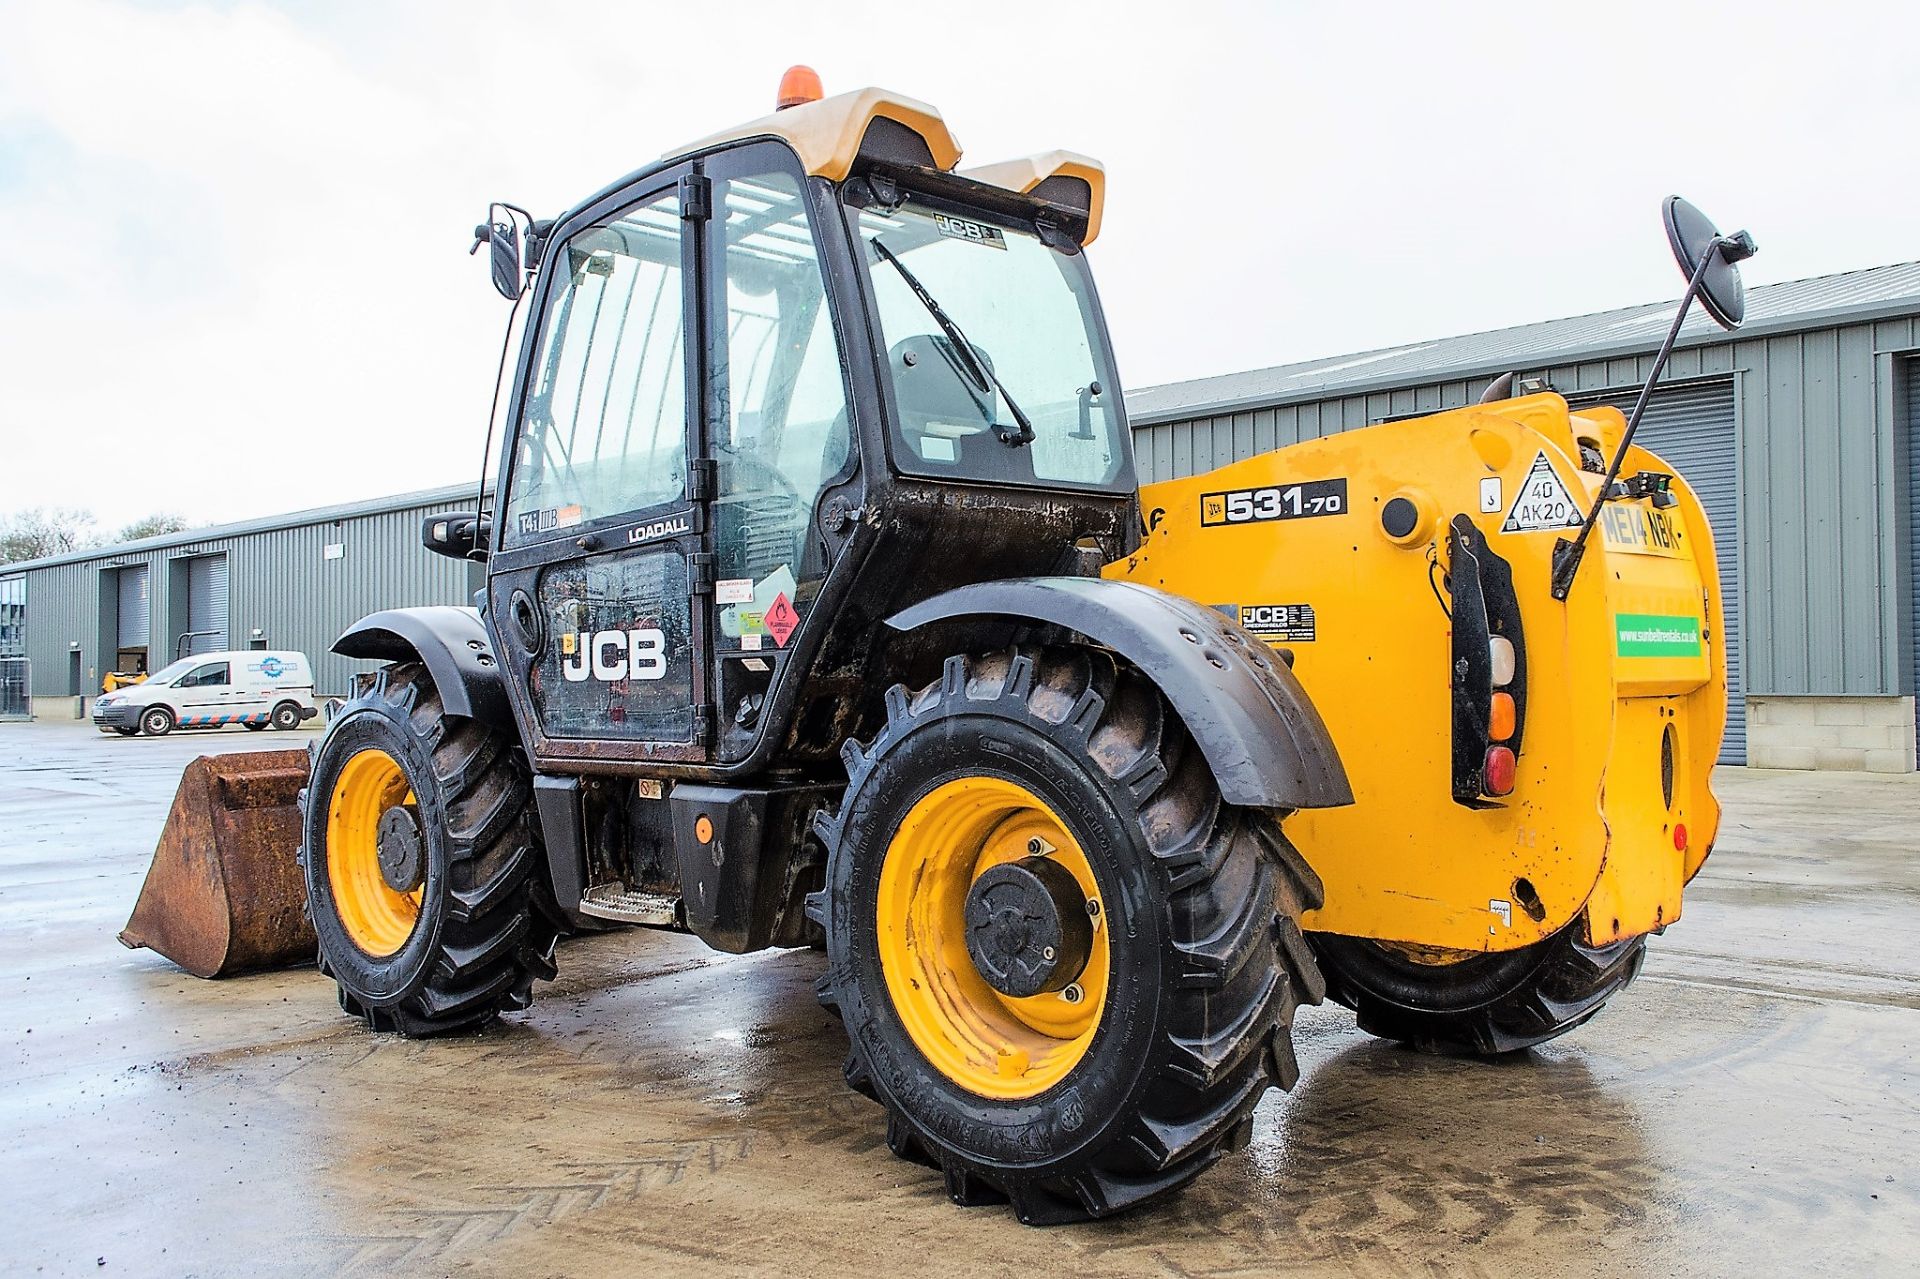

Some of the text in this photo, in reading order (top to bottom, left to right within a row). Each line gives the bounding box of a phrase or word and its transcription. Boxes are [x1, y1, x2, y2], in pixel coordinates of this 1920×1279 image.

[935, 215, 983, 239] JCB
[1532, 482, 1552, 498] 40
[1227, 486, 1341, 521] 531-70
[1521, 502, 1565, 521] AK20
[628, 518, 689, 543] LOADALL
[1647, 511, 1680, 550] NBK
[1242, 606, 1289, 623] JCB
[563, 628, 667, 682] JCB
